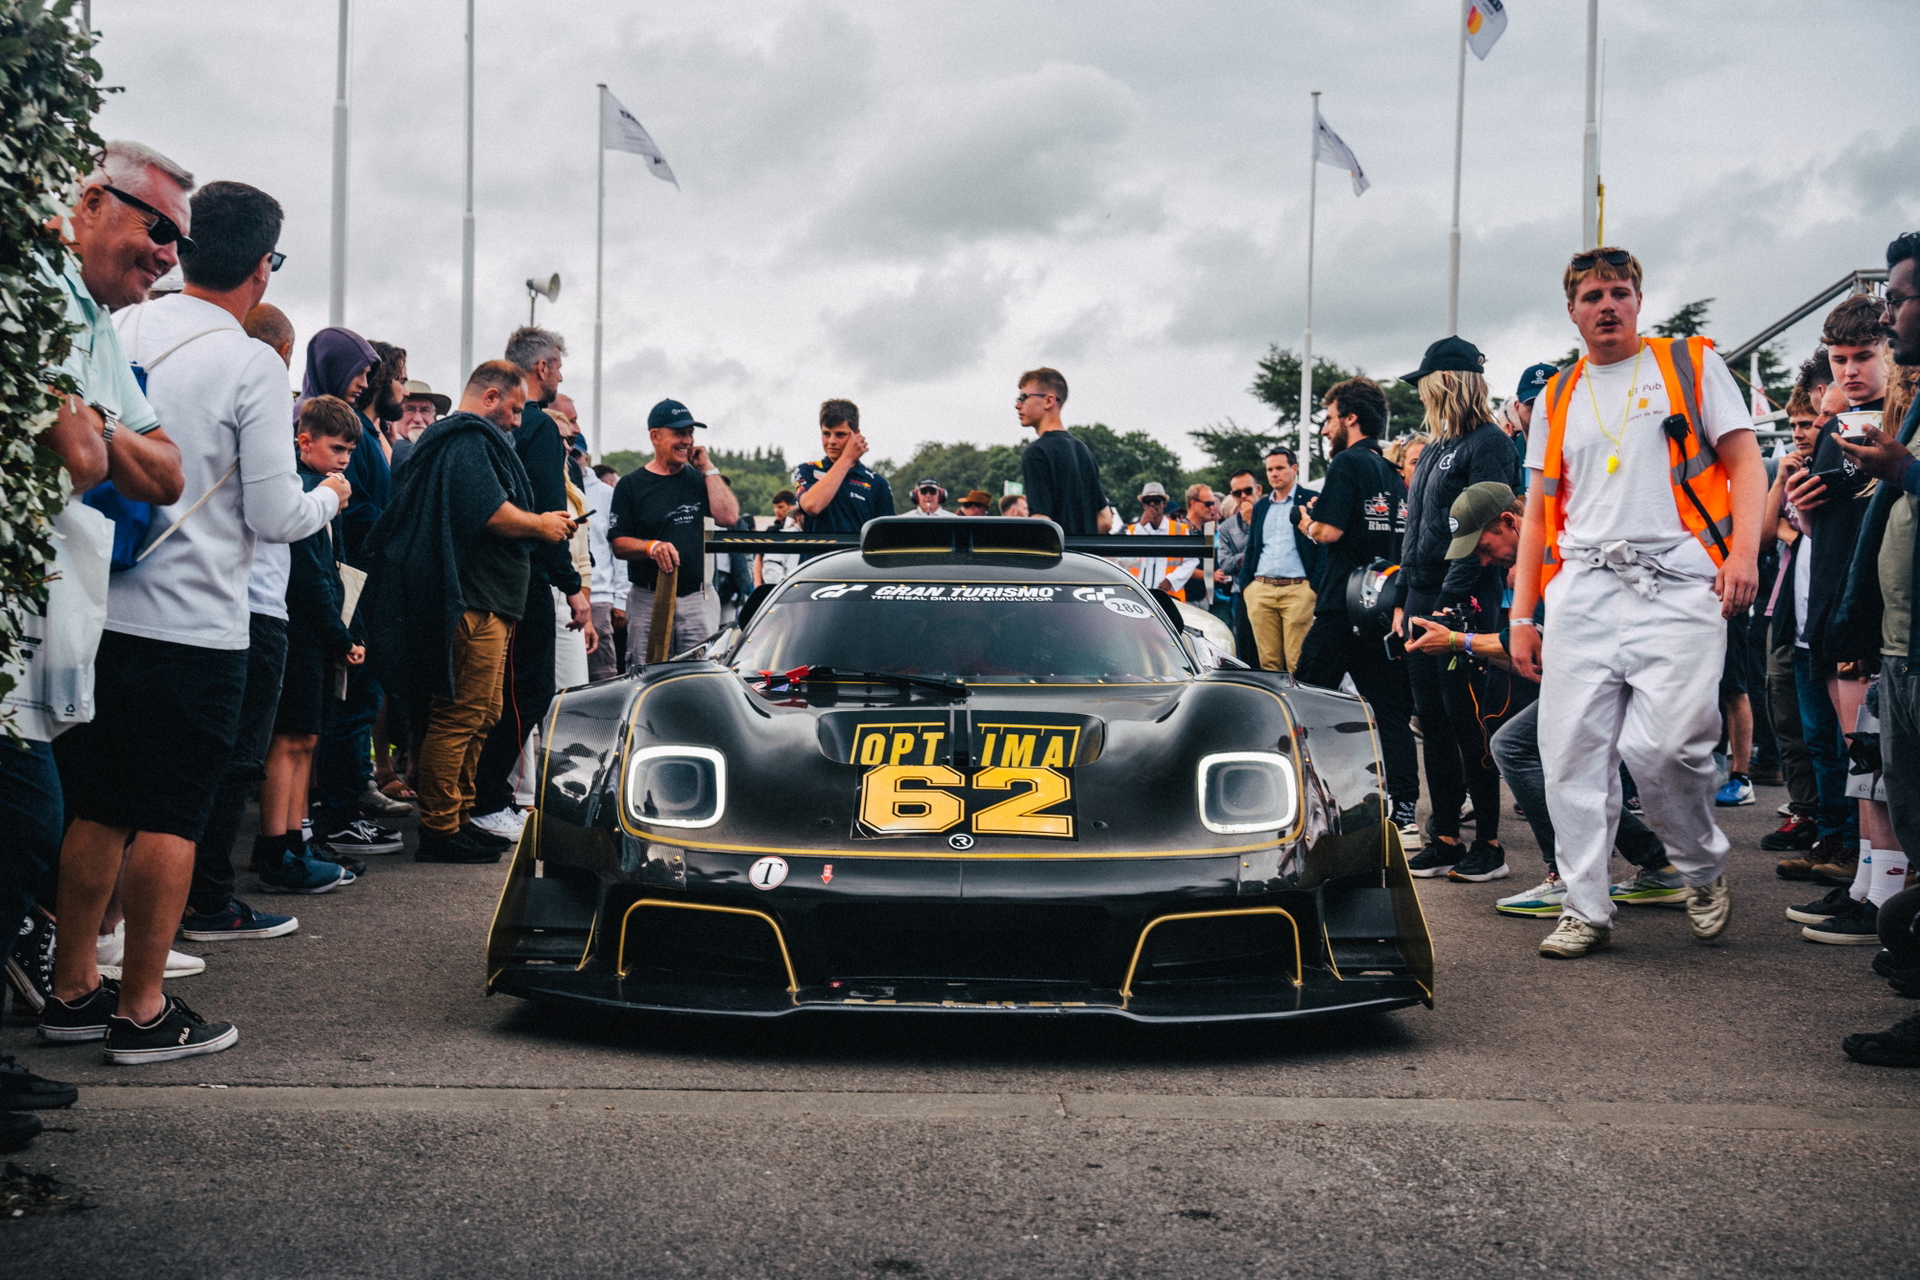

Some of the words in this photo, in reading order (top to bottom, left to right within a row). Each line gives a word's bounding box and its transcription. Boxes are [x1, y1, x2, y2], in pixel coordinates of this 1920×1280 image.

[1642, 382, 1662, 393] Pub
[874, 585, 946, 597] GRAN
[1111, 601, 1145, 614] 280
[859, 763, 1073, 837] 62
[758, 862, 783, 885] T
[177, 1027, 190, 1045] FILA
